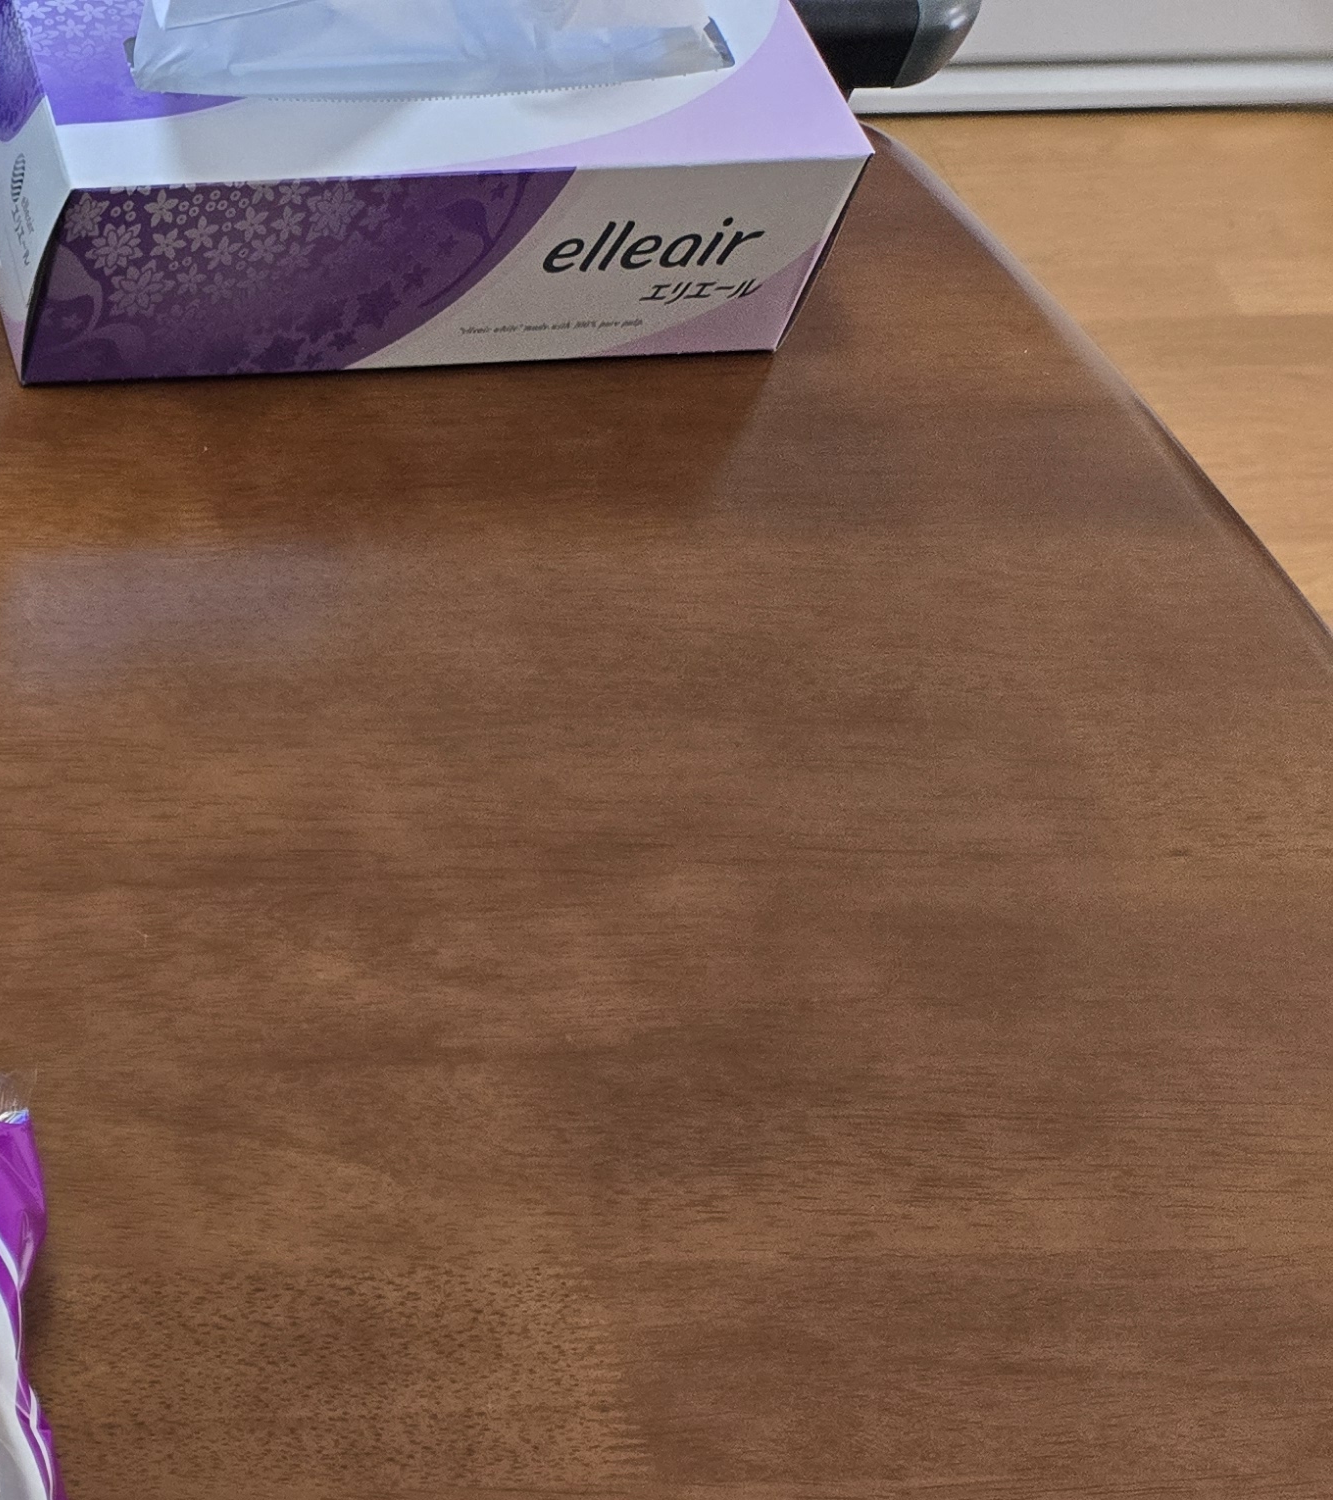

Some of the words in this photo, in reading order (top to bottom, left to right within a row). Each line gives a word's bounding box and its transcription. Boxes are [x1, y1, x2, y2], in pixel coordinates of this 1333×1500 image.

[542, 216, 766, 274] elleair
[638, 278, 764, 306] エリエール
